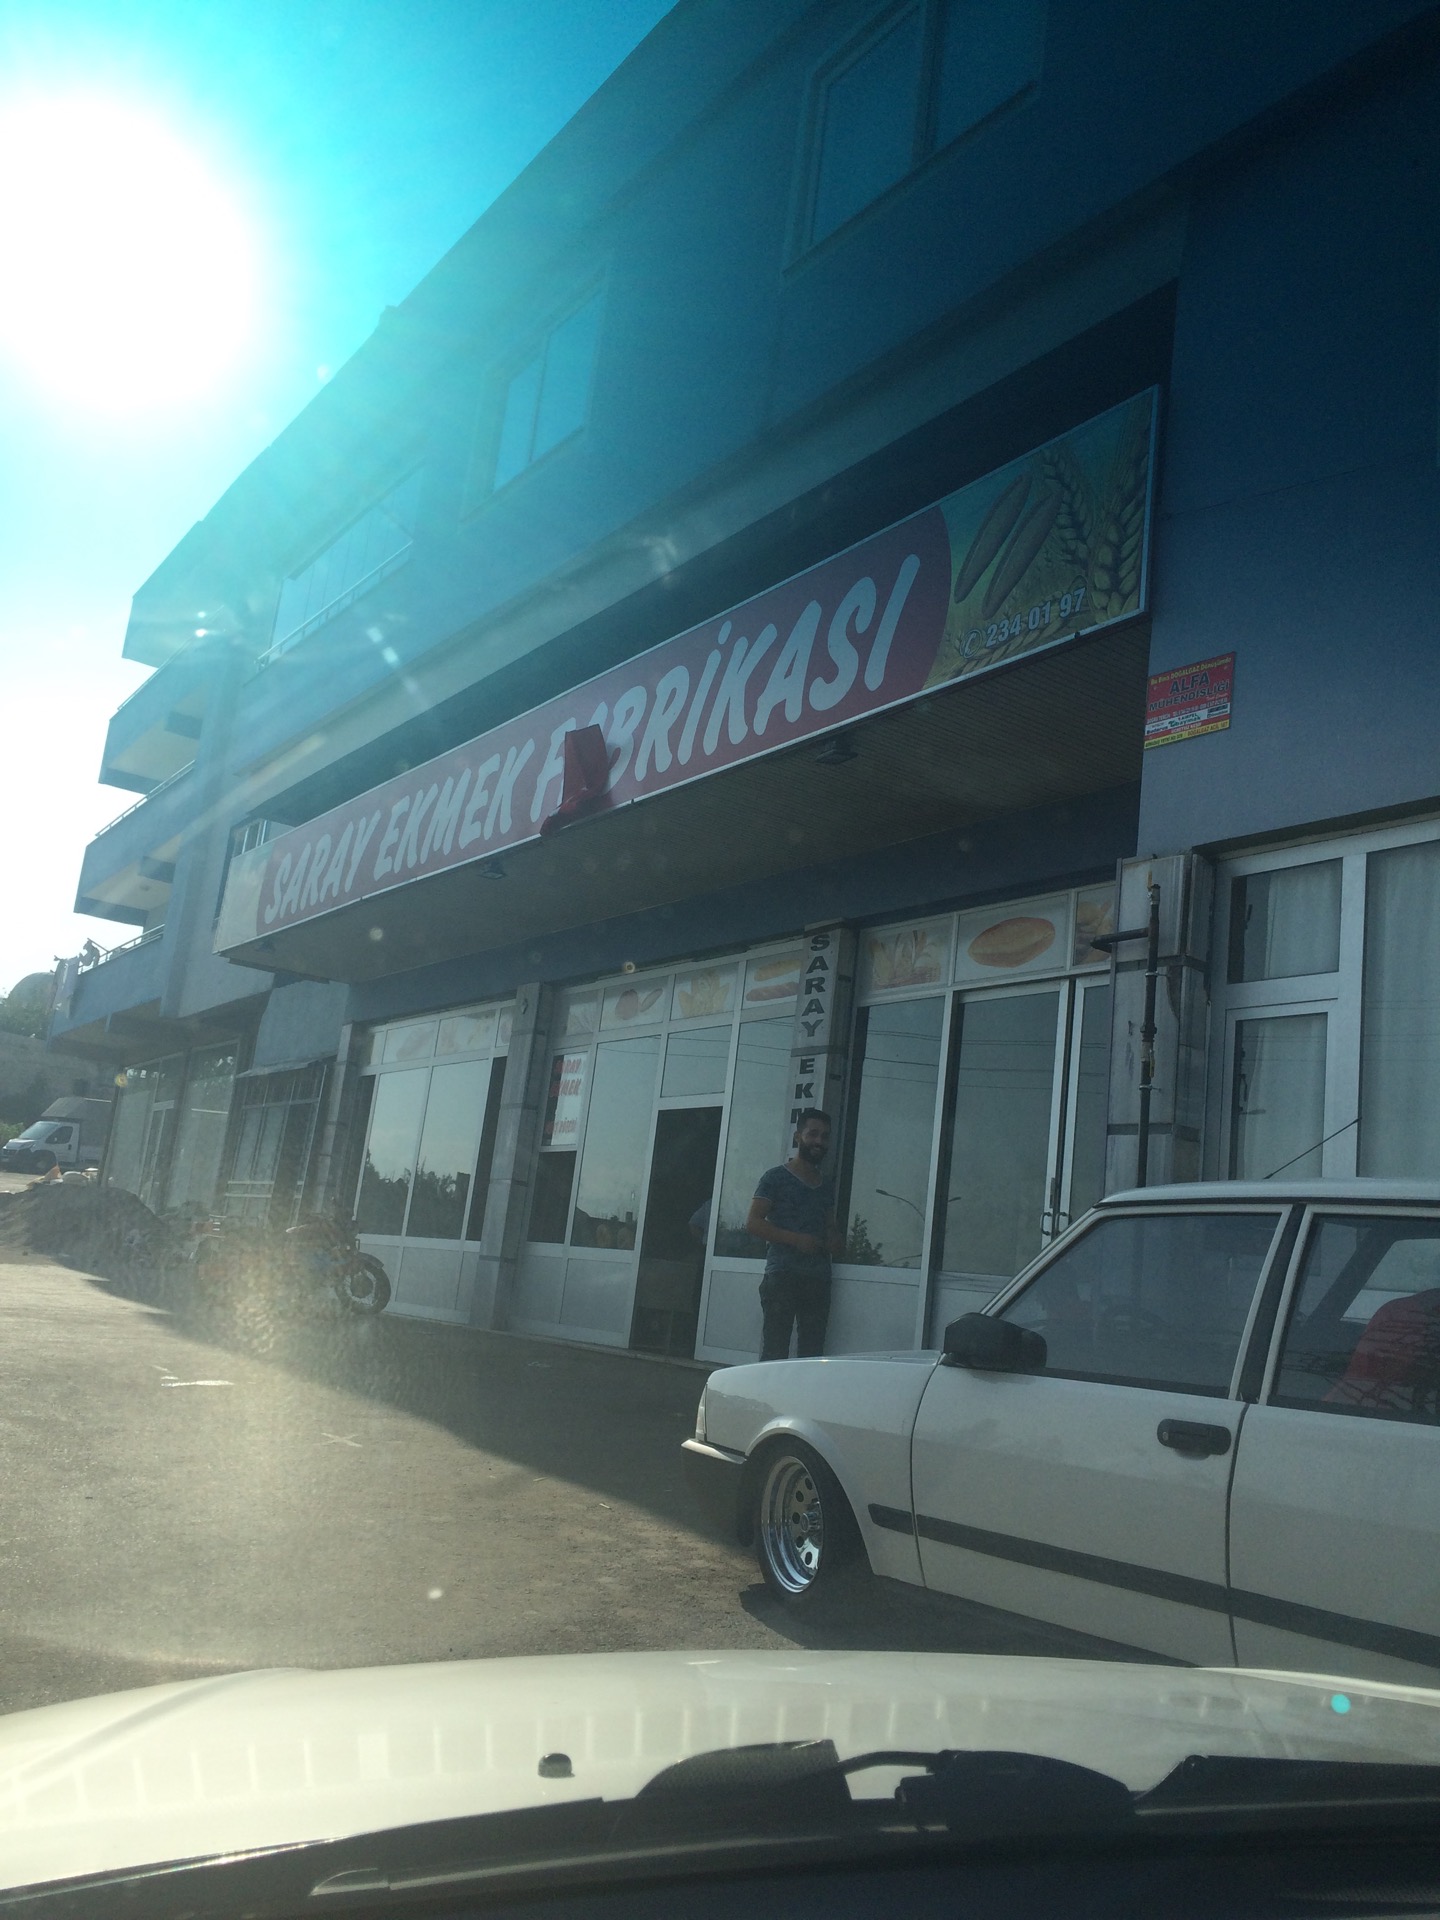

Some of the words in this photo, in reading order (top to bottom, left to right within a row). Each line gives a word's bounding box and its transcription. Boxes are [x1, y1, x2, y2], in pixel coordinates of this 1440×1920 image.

[986, 613, 1022, 648] 234
[1028, 600, 1051, 630] 01
[1059, 587, 1087, 618] 97
[1169, 671, 1210, 695] ALFA
[264, 808, 381, 924] SARAY
[373, 737, 535, 882] EKMEK
[801, 934, 830, 1038] SARAY
[790, 1057, 815, 1162] EKM
